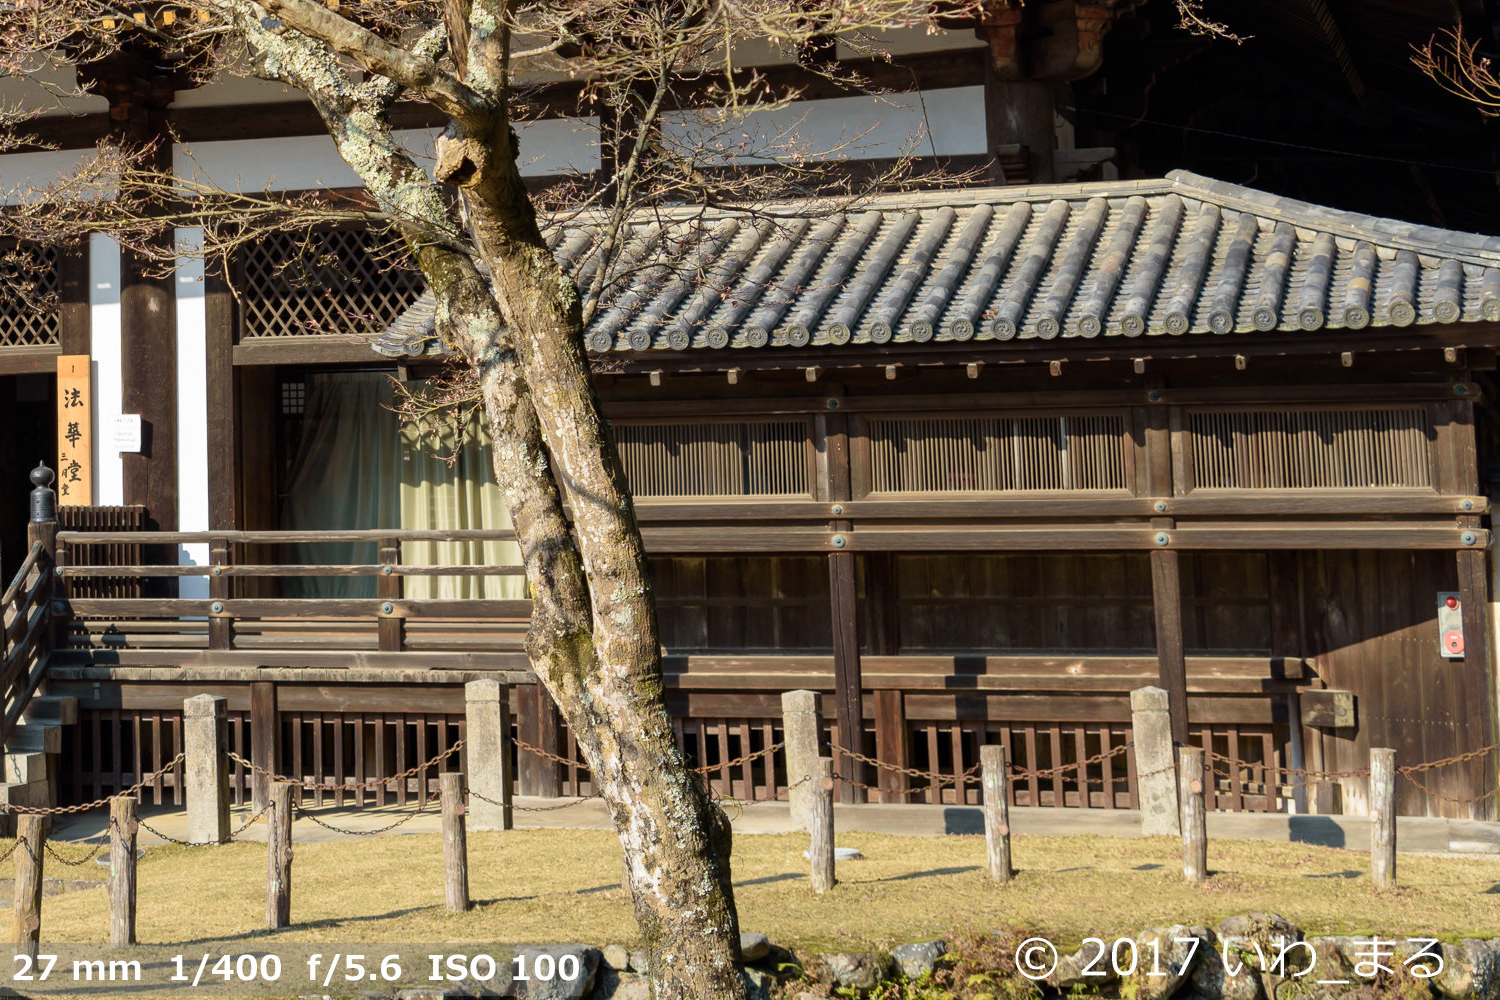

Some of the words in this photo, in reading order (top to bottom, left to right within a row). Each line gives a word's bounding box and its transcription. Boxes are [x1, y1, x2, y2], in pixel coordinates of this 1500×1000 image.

[64, 387, 84, 482] 法華堂
[60, 452, 71, 497] 三月堂
